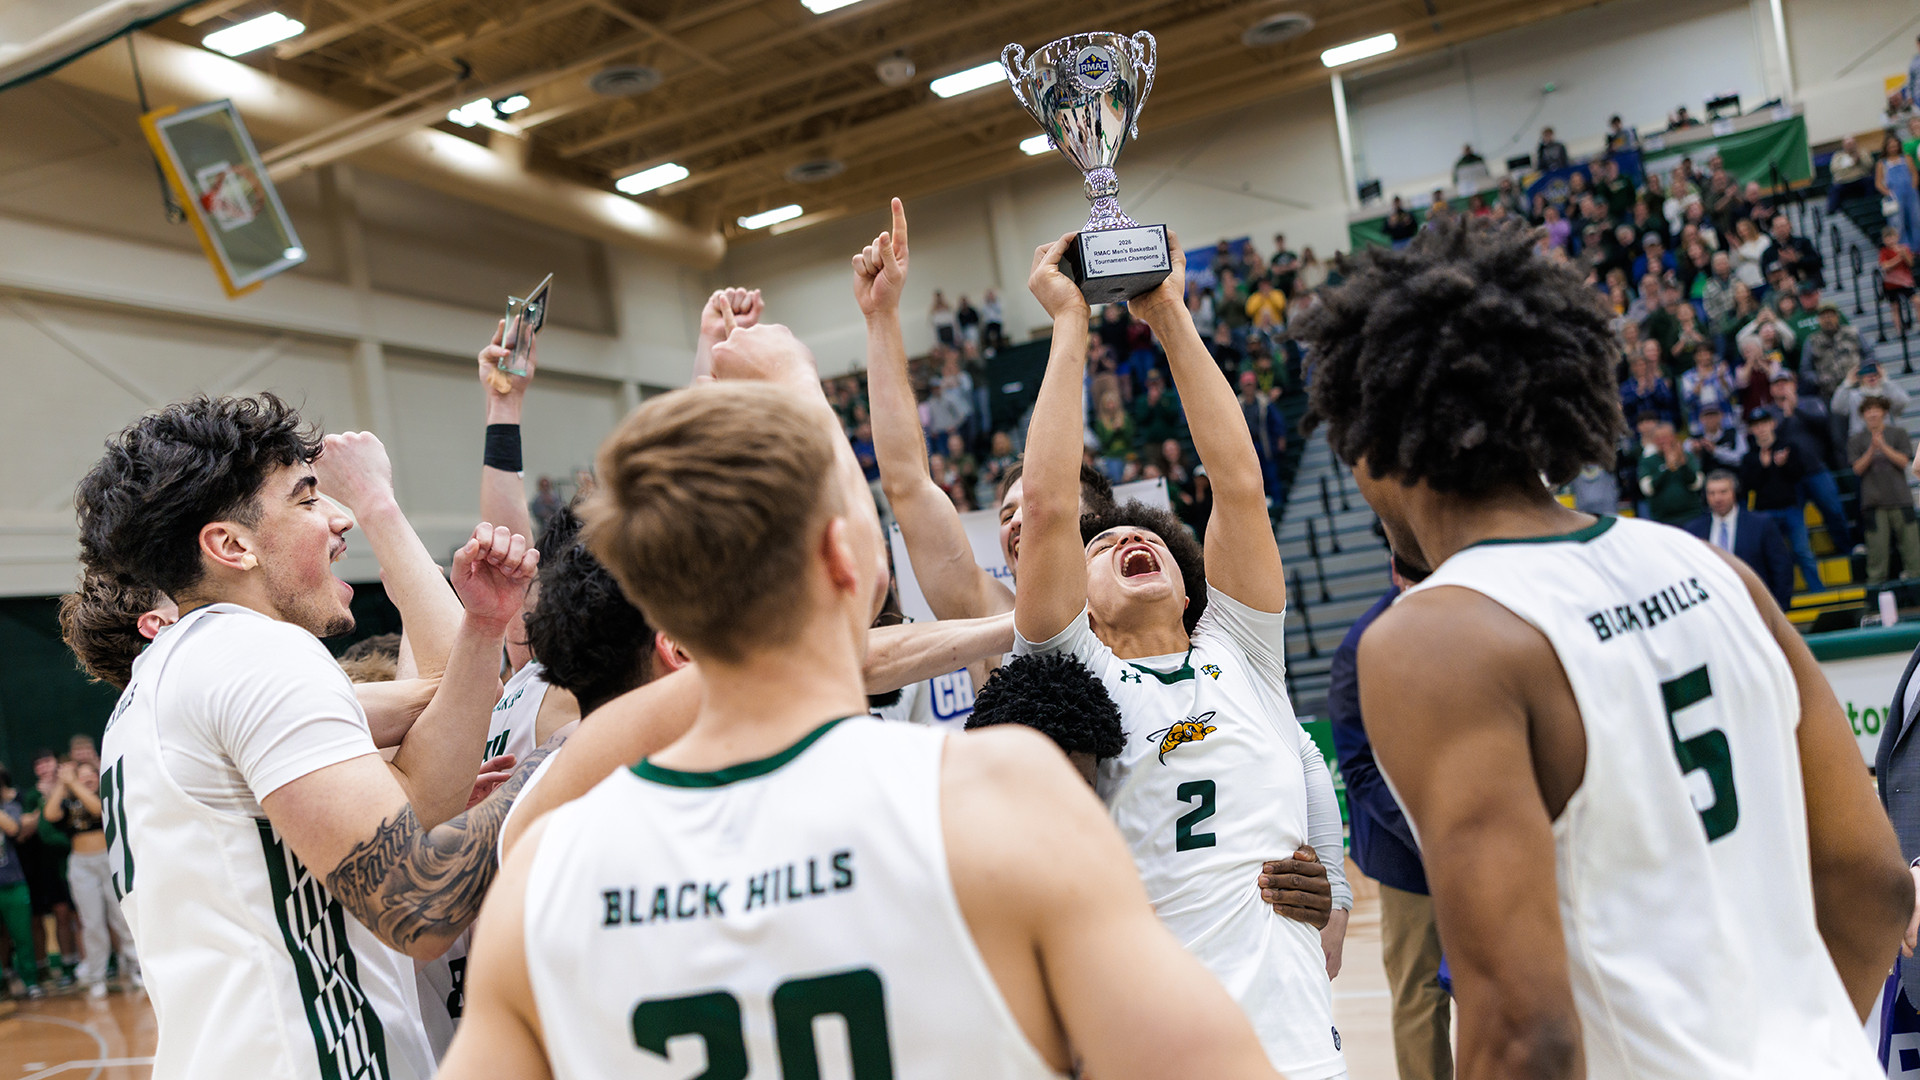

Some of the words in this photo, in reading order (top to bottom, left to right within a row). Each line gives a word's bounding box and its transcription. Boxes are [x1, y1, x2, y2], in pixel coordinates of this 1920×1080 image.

[1081, 61, 1108, 73] RMAC
[1093, 249, 1111, 257] RMAC
[1129, 245, 1158, 253] Basketball
[1095, 257, 1127, 265] Tournament
[1128, 254, 1159, 262] Champions
[1638, 577, 1710, 628] HILLS
[1659, 663, 1739, 844] 5
[1176, 779, 1217, 853] 2
[601, 881, 729, 928] BLACK
[744, 850, 855, 913] HILLS
